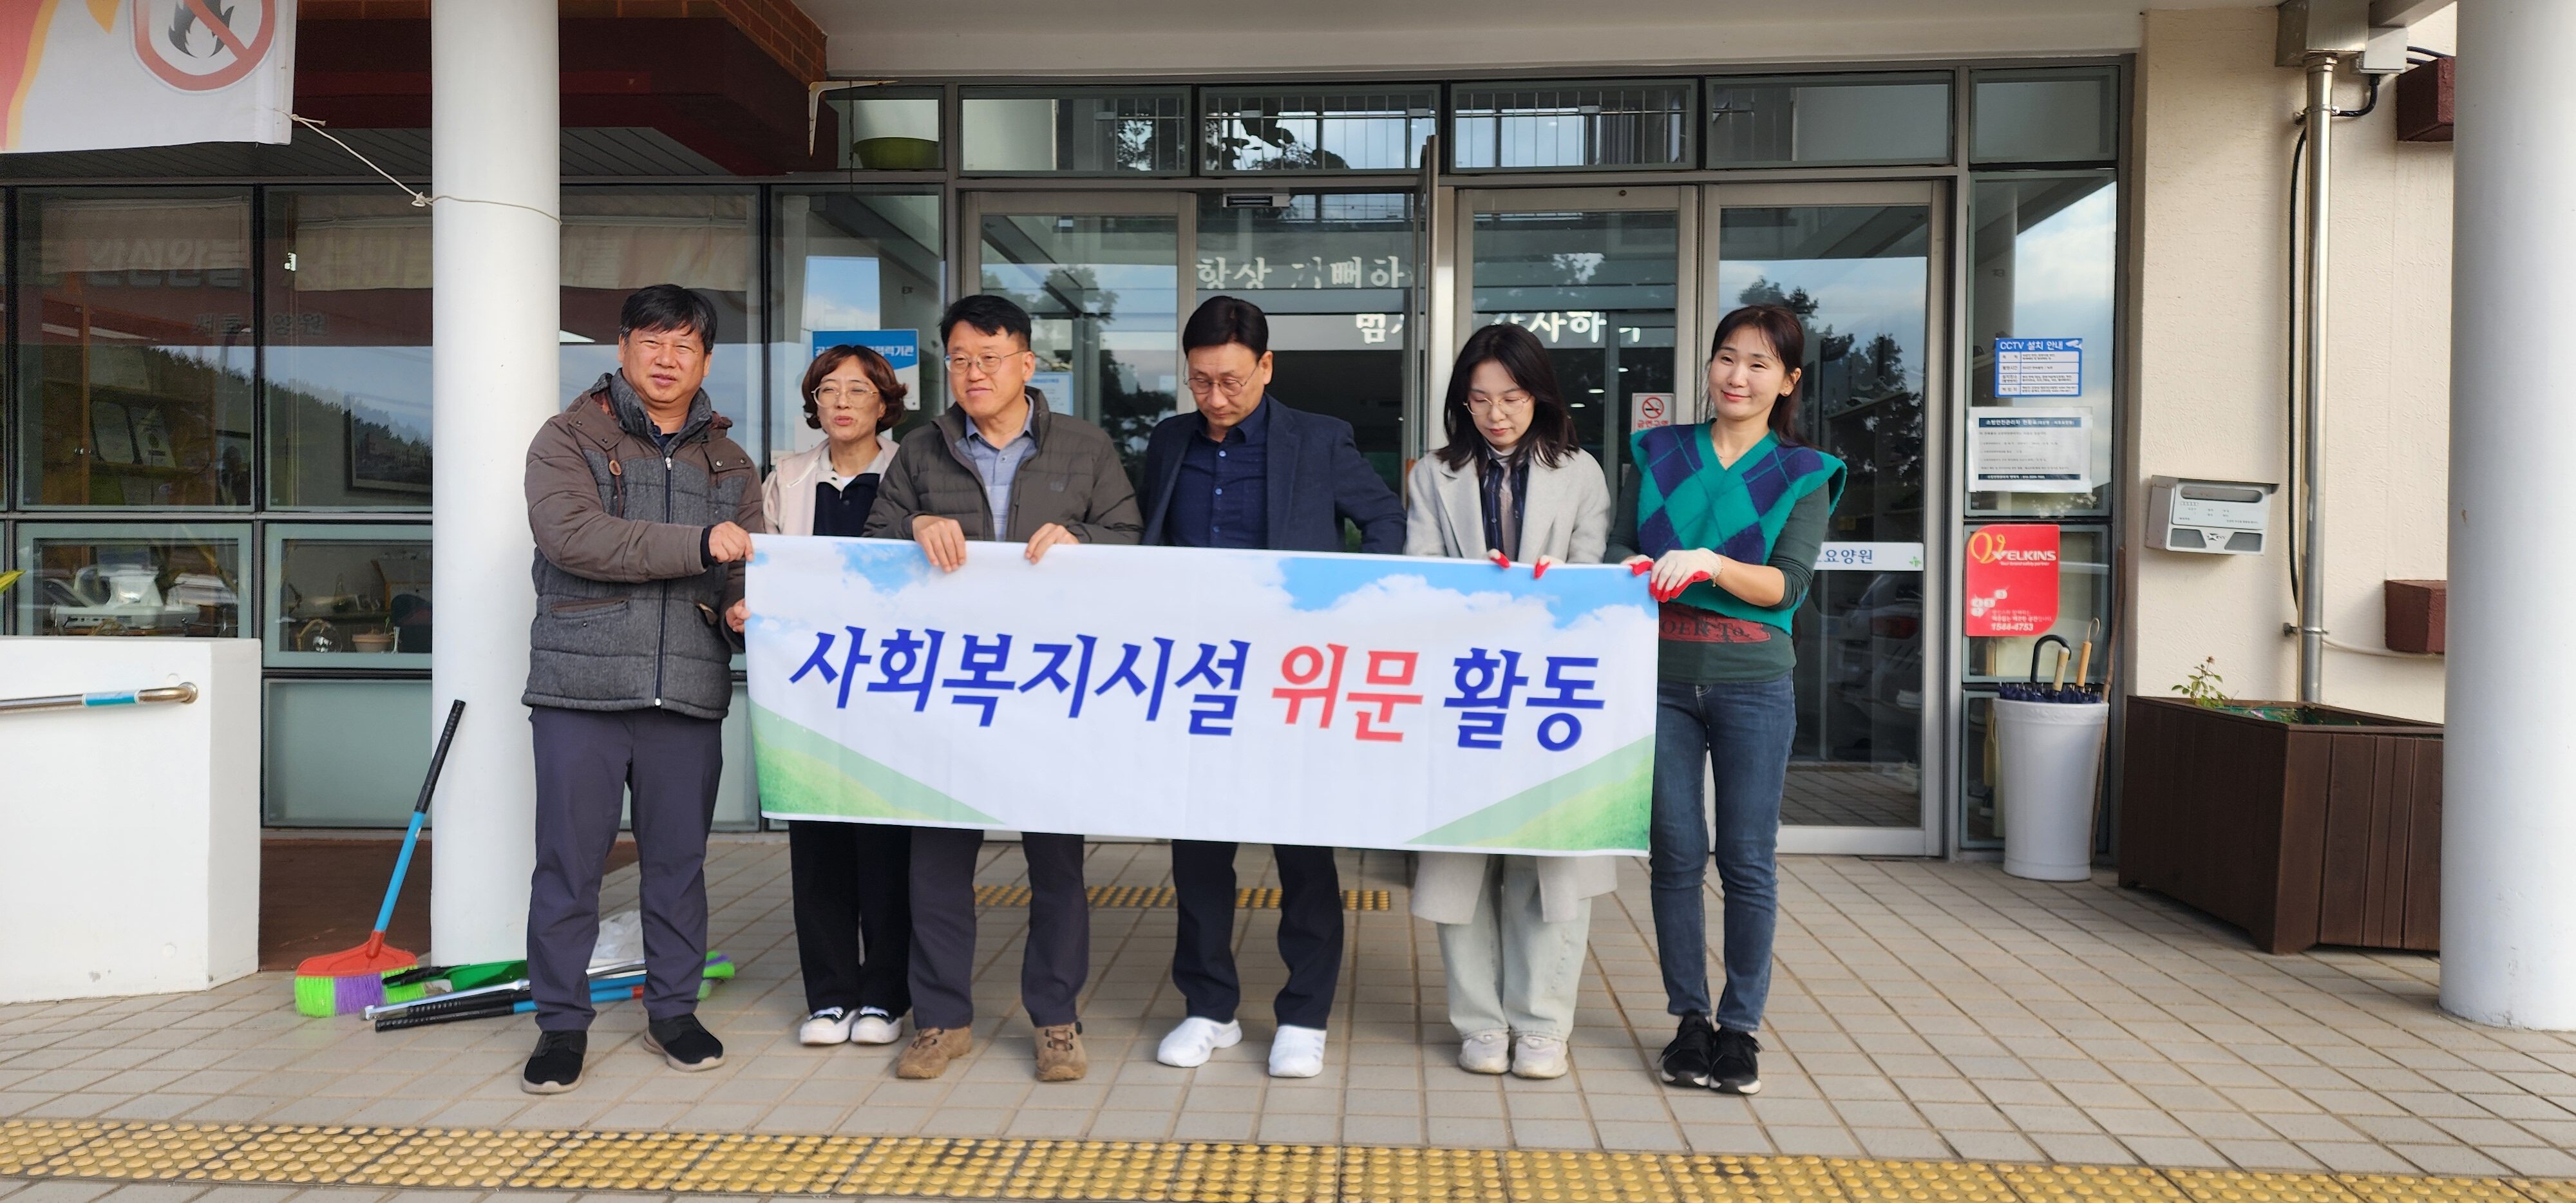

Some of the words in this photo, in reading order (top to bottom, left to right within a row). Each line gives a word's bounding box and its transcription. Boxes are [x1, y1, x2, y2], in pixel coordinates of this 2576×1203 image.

[1196, 256, 1273, 289] 항상
[1290, 256, 1413, 289] 기뻐하
[2000, 341, 2024, 350] CCTV
[2027, 341, 2043, 351] 설치
[2047, 341, 2063, 351] 안내
[1816, 549, 1873, 565] 요양원
[1991, 550, 2057, 561] VELKINS
[1991, 623, 2034, 631] 1544-4753
[790, 625, 1251, 736] 사회복지시설
[1271, 643, 1423, 743] 위문
[1444, 647, 1606, 753] 활동
